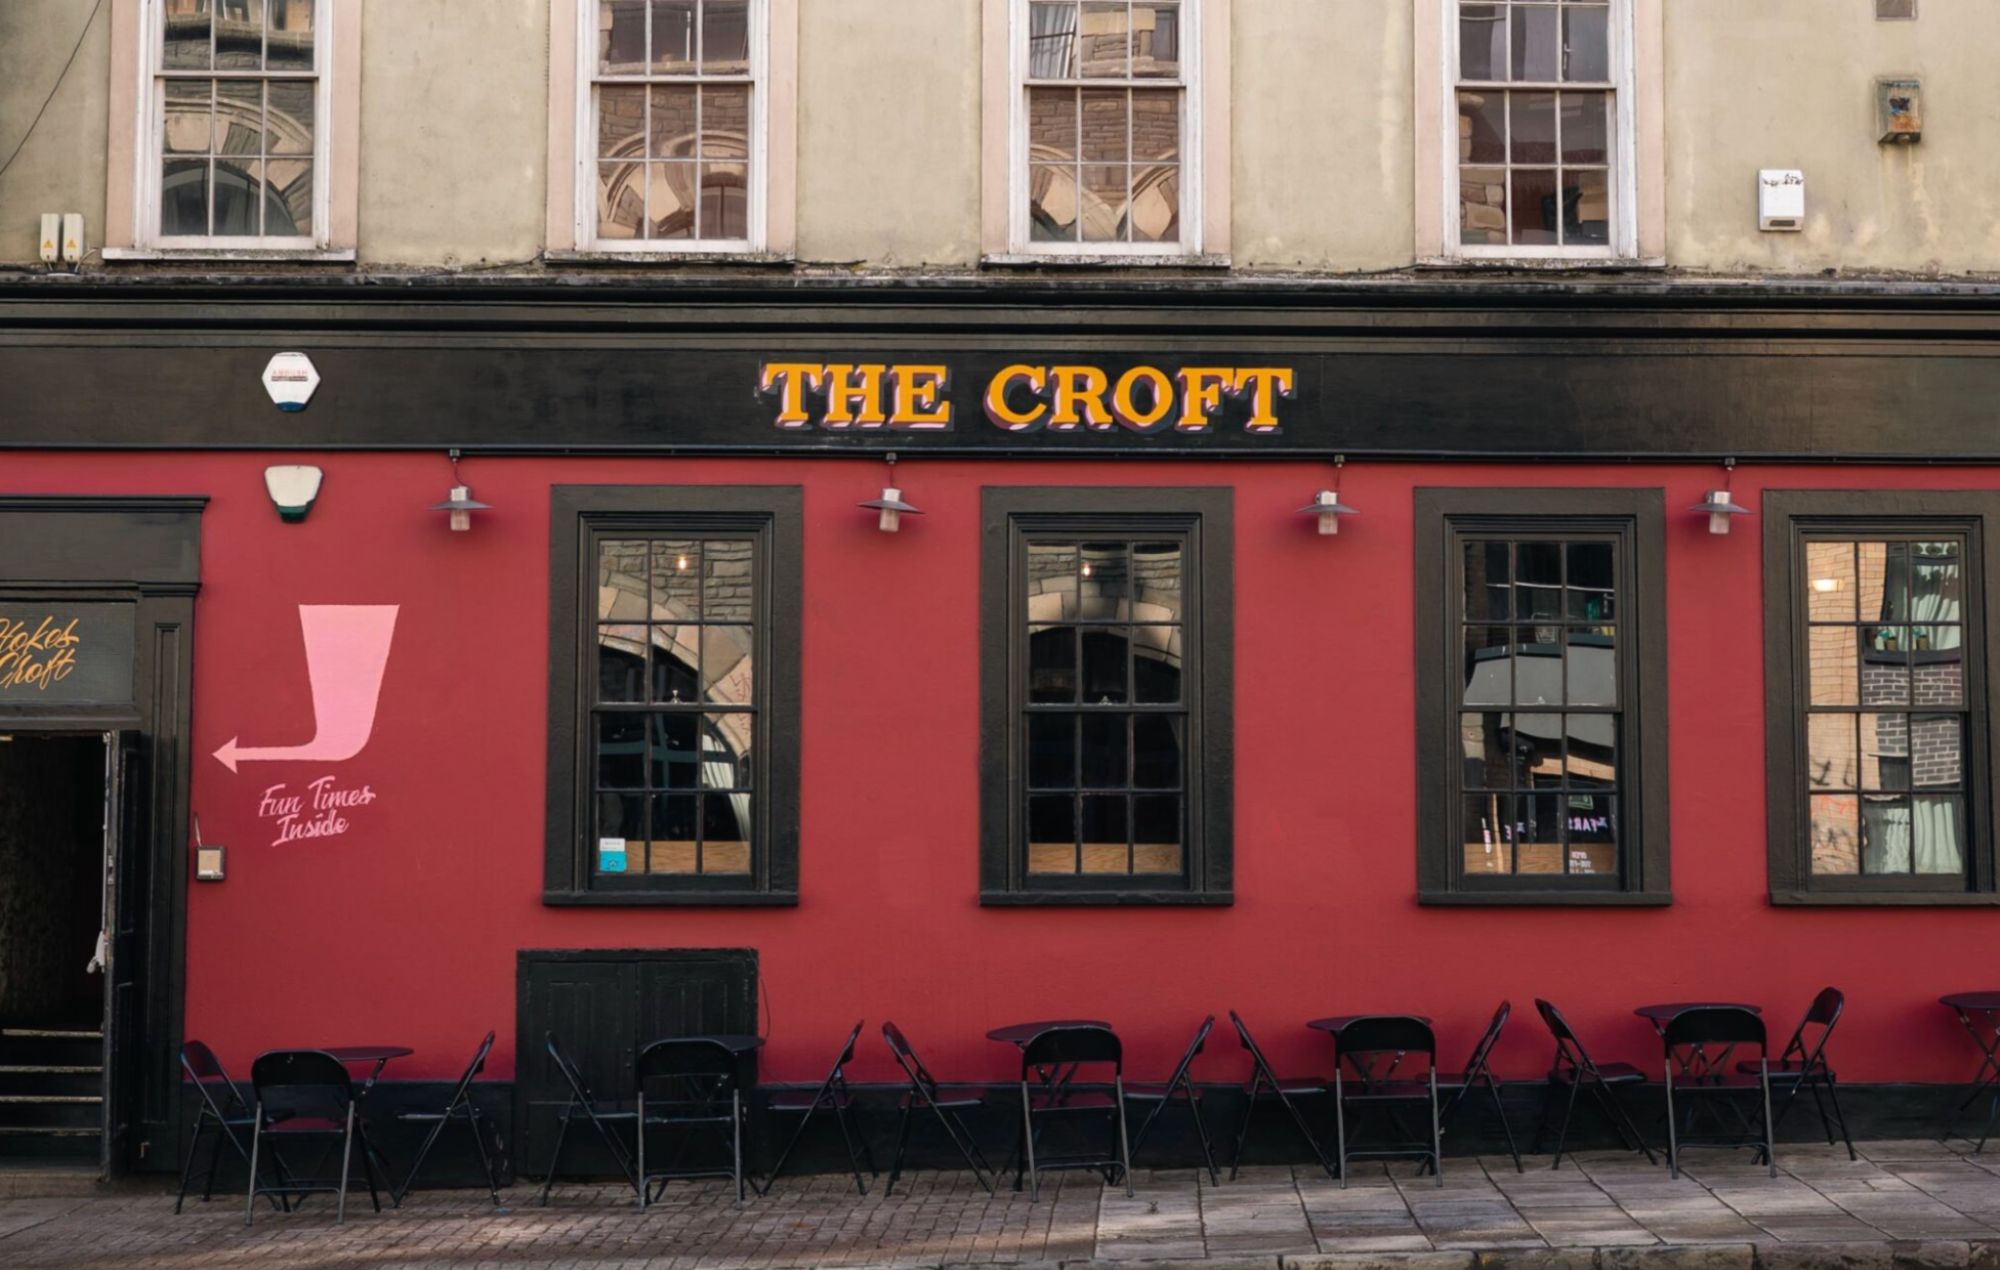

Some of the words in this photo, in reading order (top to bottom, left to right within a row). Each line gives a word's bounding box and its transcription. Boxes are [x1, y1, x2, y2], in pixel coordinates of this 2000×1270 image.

[760, 363, 953, 431] THE
[984, 364, 1294, 434] CROFT
[258, 783, 303, 817] Fun
[307, 775, 376, 810] Times
[271, 809, 350, 847] Inside
